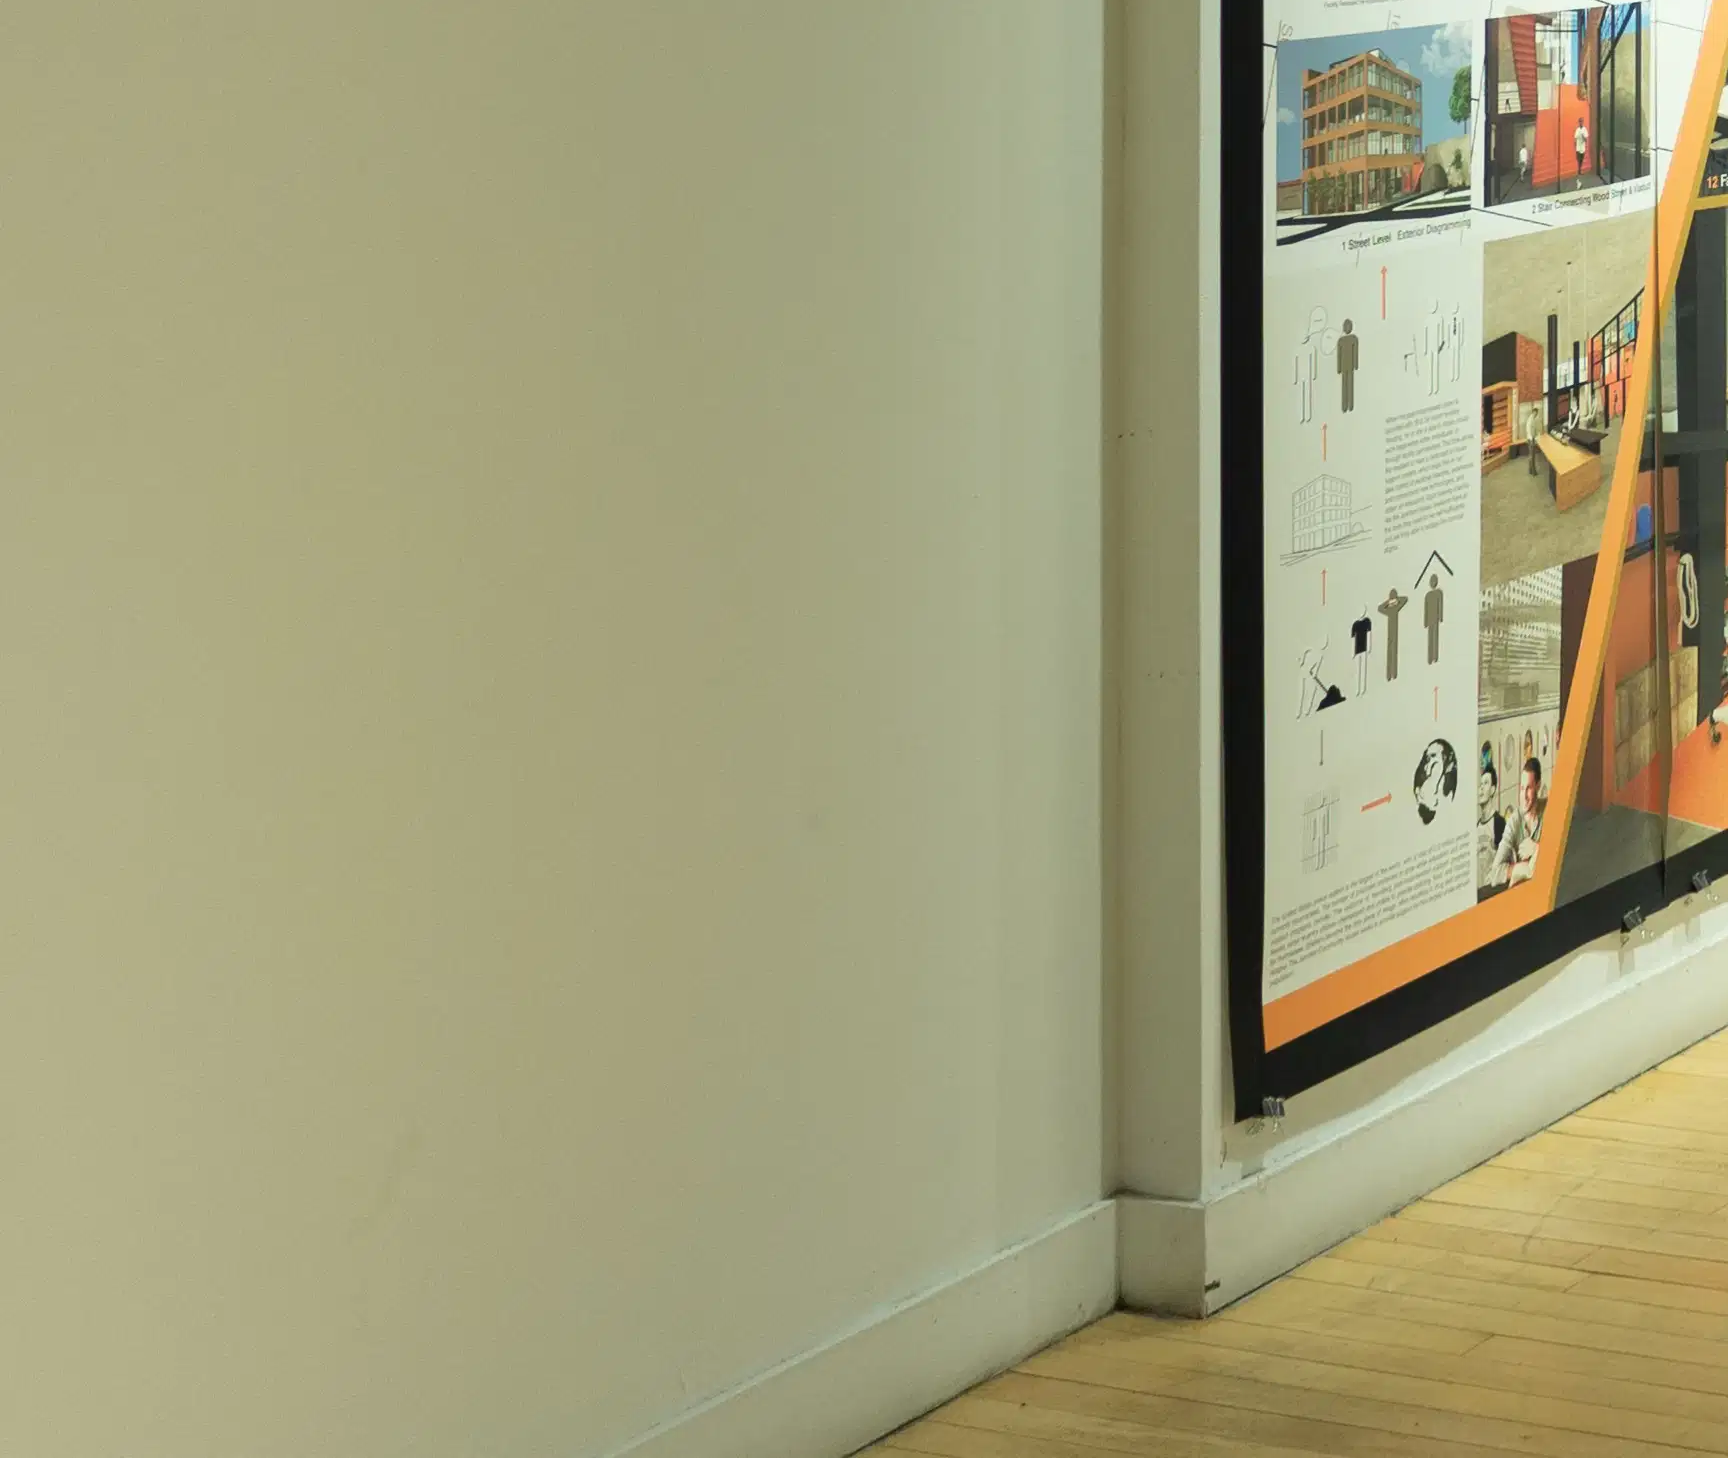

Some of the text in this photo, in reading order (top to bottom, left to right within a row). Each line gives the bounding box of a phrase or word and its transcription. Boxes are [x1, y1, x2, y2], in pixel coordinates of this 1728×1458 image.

[1706, 175, 1719, 189] 12
[1537, 202, 1553, 214] Stair
[1555, 194, 1592, 210] Connecting
[1592, 191, 1610, 203] Wood
[1348, 236, 1371, 251] Street
[1373, 232, 1392, 246] Level
[1397, 227, 1425, 241] Exterior
[1426, 218, 1472, 235] Diagramming
